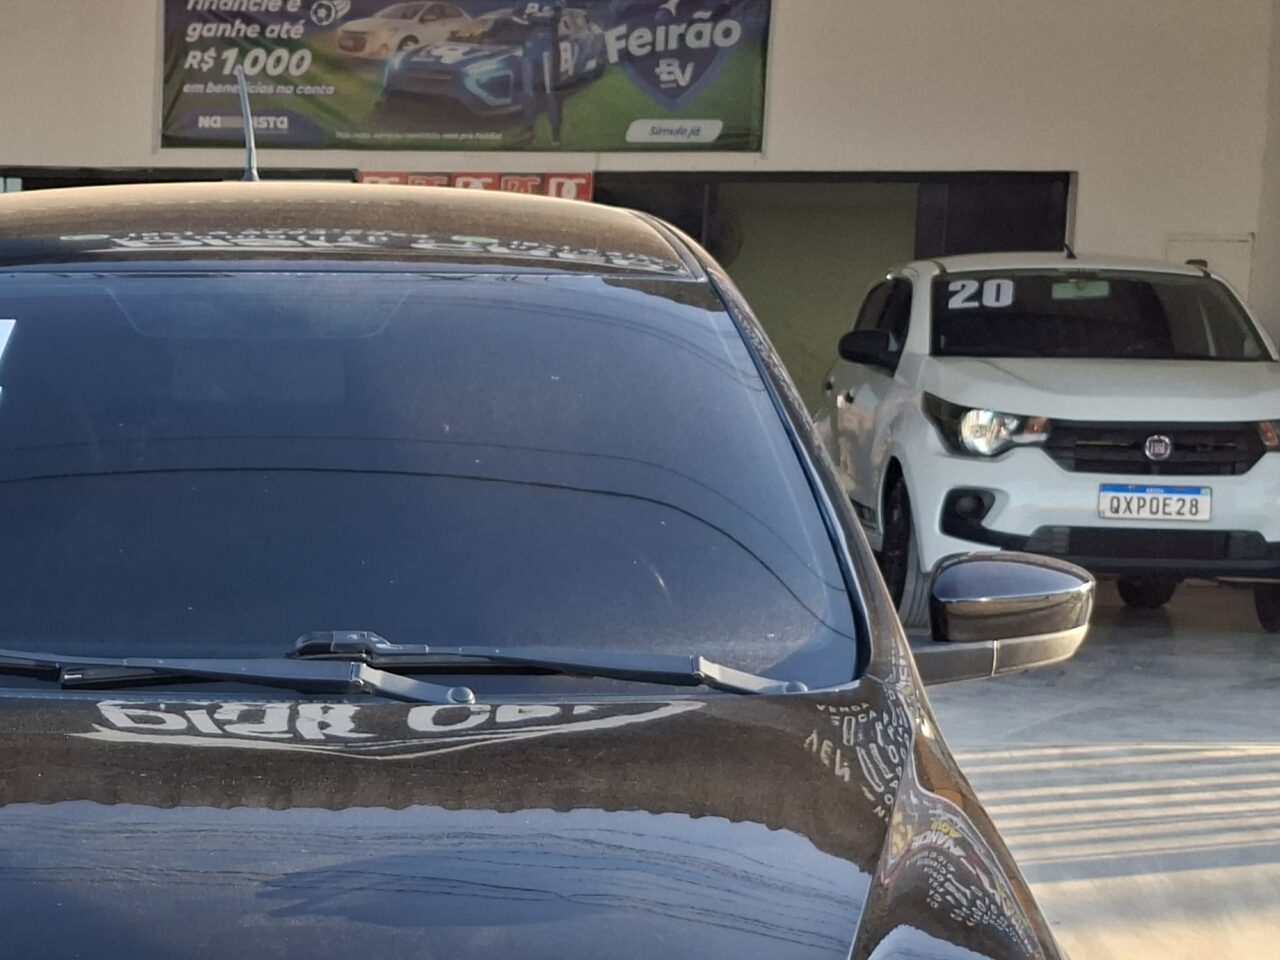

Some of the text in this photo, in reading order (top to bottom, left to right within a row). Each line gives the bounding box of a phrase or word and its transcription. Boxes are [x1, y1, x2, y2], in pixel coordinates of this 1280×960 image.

[185, 19, 306, 42] ganhe até
[605, 11, 742, 64] Feirão
[183, 83, 204, 93] em
[296, 84, 336, 95] conta
[948, 278, 1014, 310] 20
